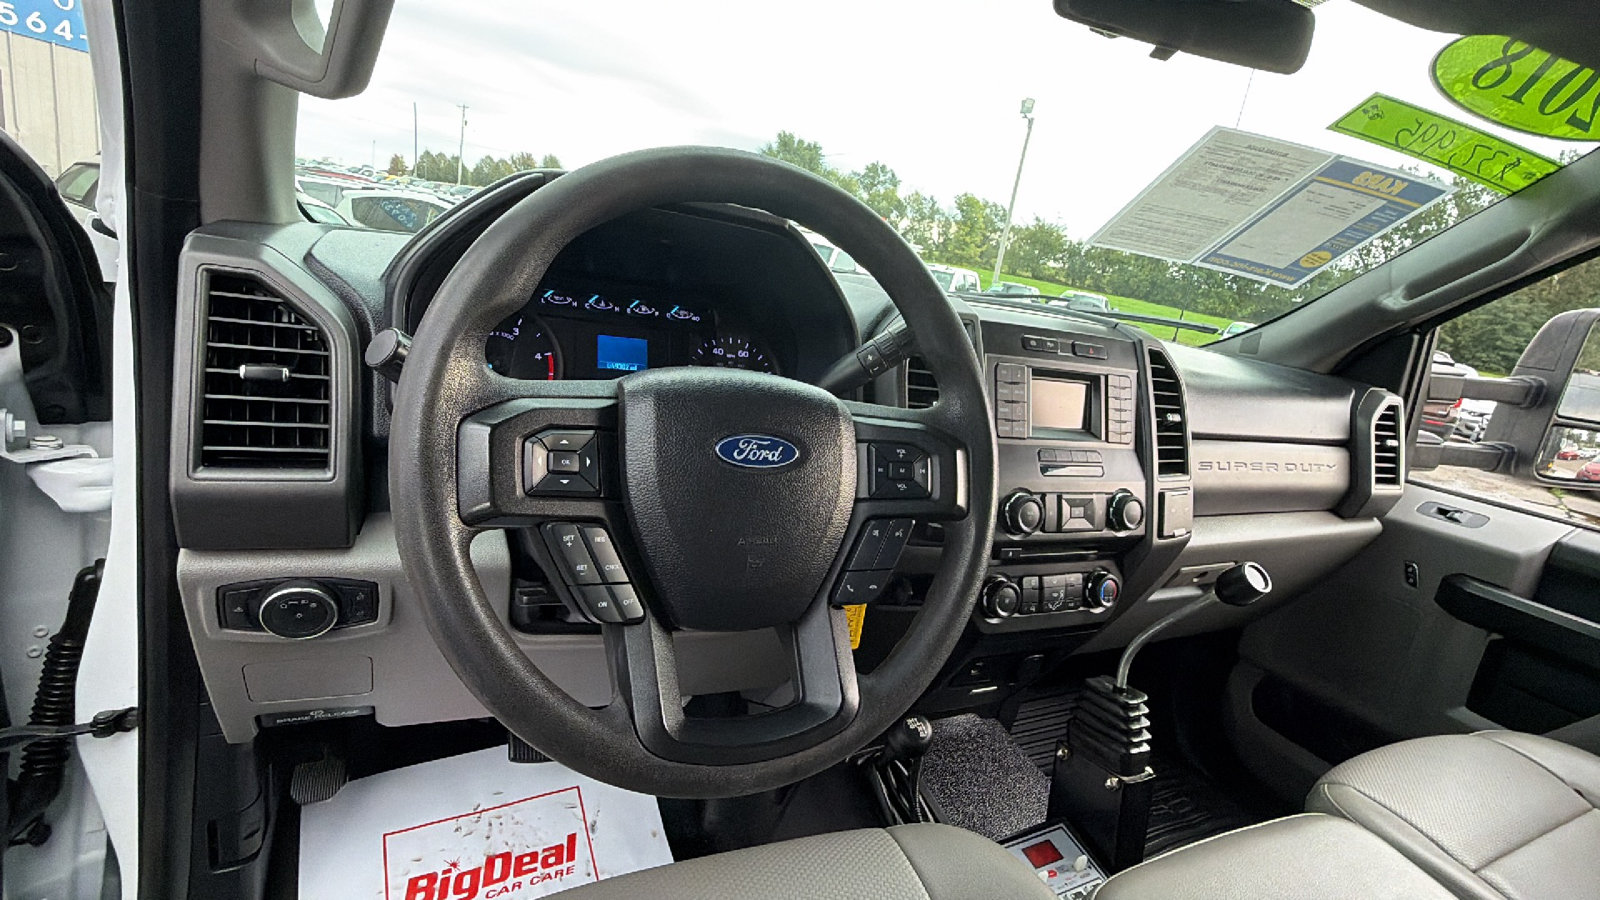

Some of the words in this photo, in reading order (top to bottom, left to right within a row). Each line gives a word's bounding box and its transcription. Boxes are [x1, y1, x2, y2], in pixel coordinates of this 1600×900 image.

[512, 327, 520, 336] 3
[733, 438, 783, 462] Ford
[1198, 461, 1279, 472] SUPER
[1285, 462, 1337, 472] DUTY
[563, 534, 575, 542] SET
[404, 832, 577, 900] BigDeal
[485, 881, 523, 899] CAR
[529, 865, 576, 886] CARE
